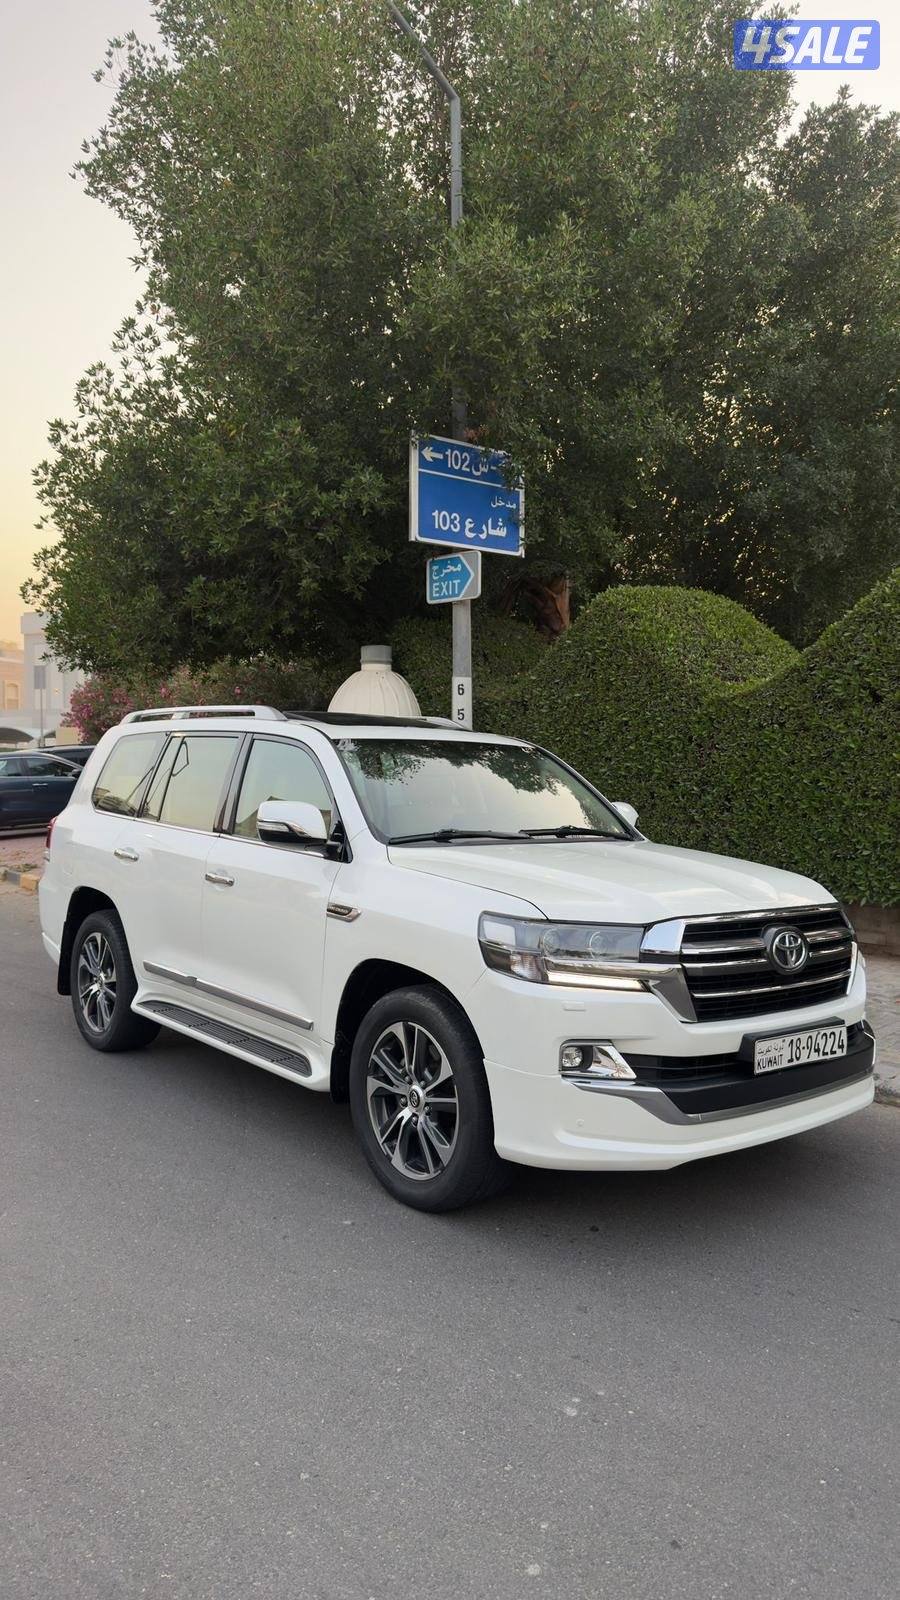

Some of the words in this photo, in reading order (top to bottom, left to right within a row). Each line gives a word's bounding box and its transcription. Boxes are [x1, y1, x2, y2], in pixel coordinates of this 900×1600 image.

[445, 448, 471, 472] 102
[490, 495, 517, 509] مدخل
[431, 509, 460, 533] 103
[464, 517, 507, 540] شارع
[432, 560, 462, 580] مخرج
[432, 579, 461, 597] EXIT
[457, 683, 465, 696] 6
[457, 708, 465, 721] 5
[787, 1029, 845, 1063] 18-94224
[757, 1054, 784, 1071] KUWAIT
